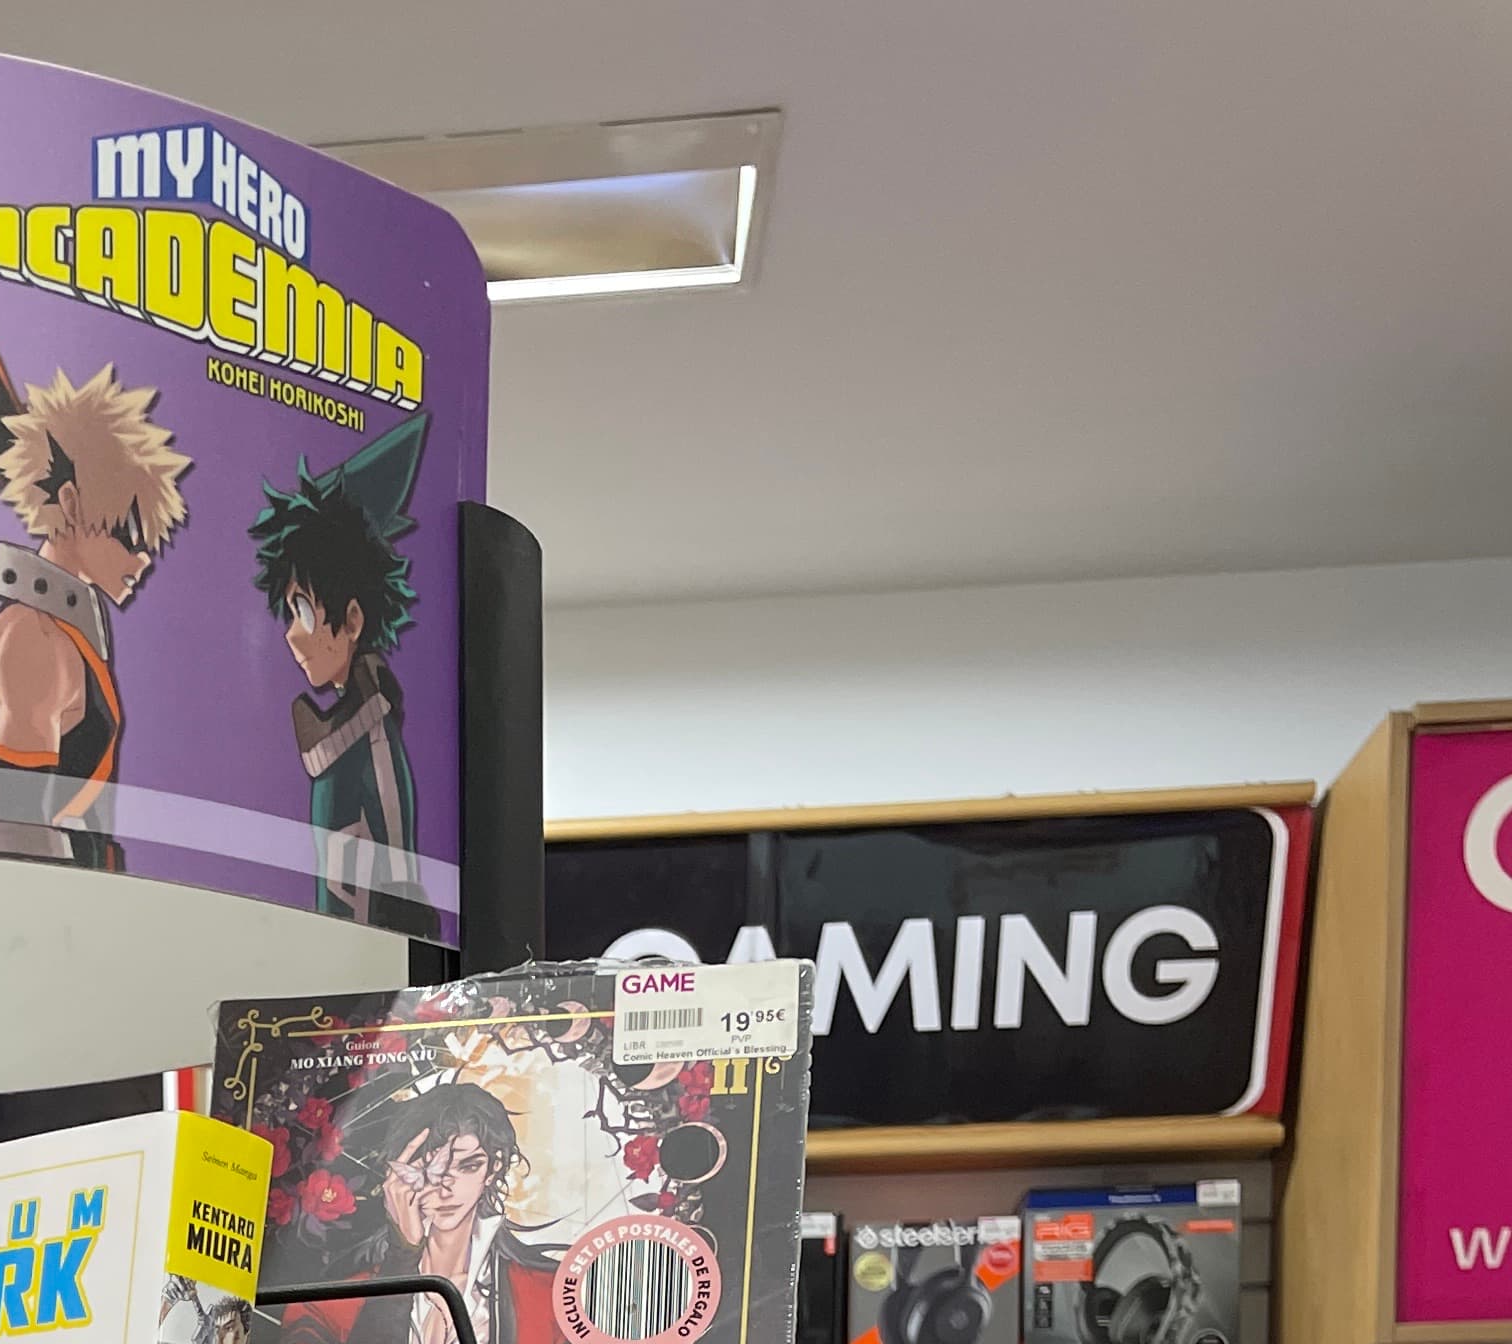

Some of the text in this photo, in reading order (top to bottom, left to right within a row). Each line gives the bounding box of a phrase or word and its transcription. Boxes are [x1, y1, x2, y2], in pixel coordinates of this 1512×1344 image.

[95, 125, 307, 260] MY HERO
[208, 357, 365, 433] KOHEI HORIKOSHI
[622, 973, 696, 994] GAME
[346, 1038, 381, 1051] Guion
[656, 1049, 693, 1060] Heaven
[731, 1035, 752, 1044] PVP
[289, 1047, 438, 1071] MO XIANG TONG XIU
[191, 1200, 255, 1240] KENTARO
[186, 1227, 253, 1273] MIURA
[562, 1223, 711, 1340] INCLUYE SET DE POSTALES DE REGALO
